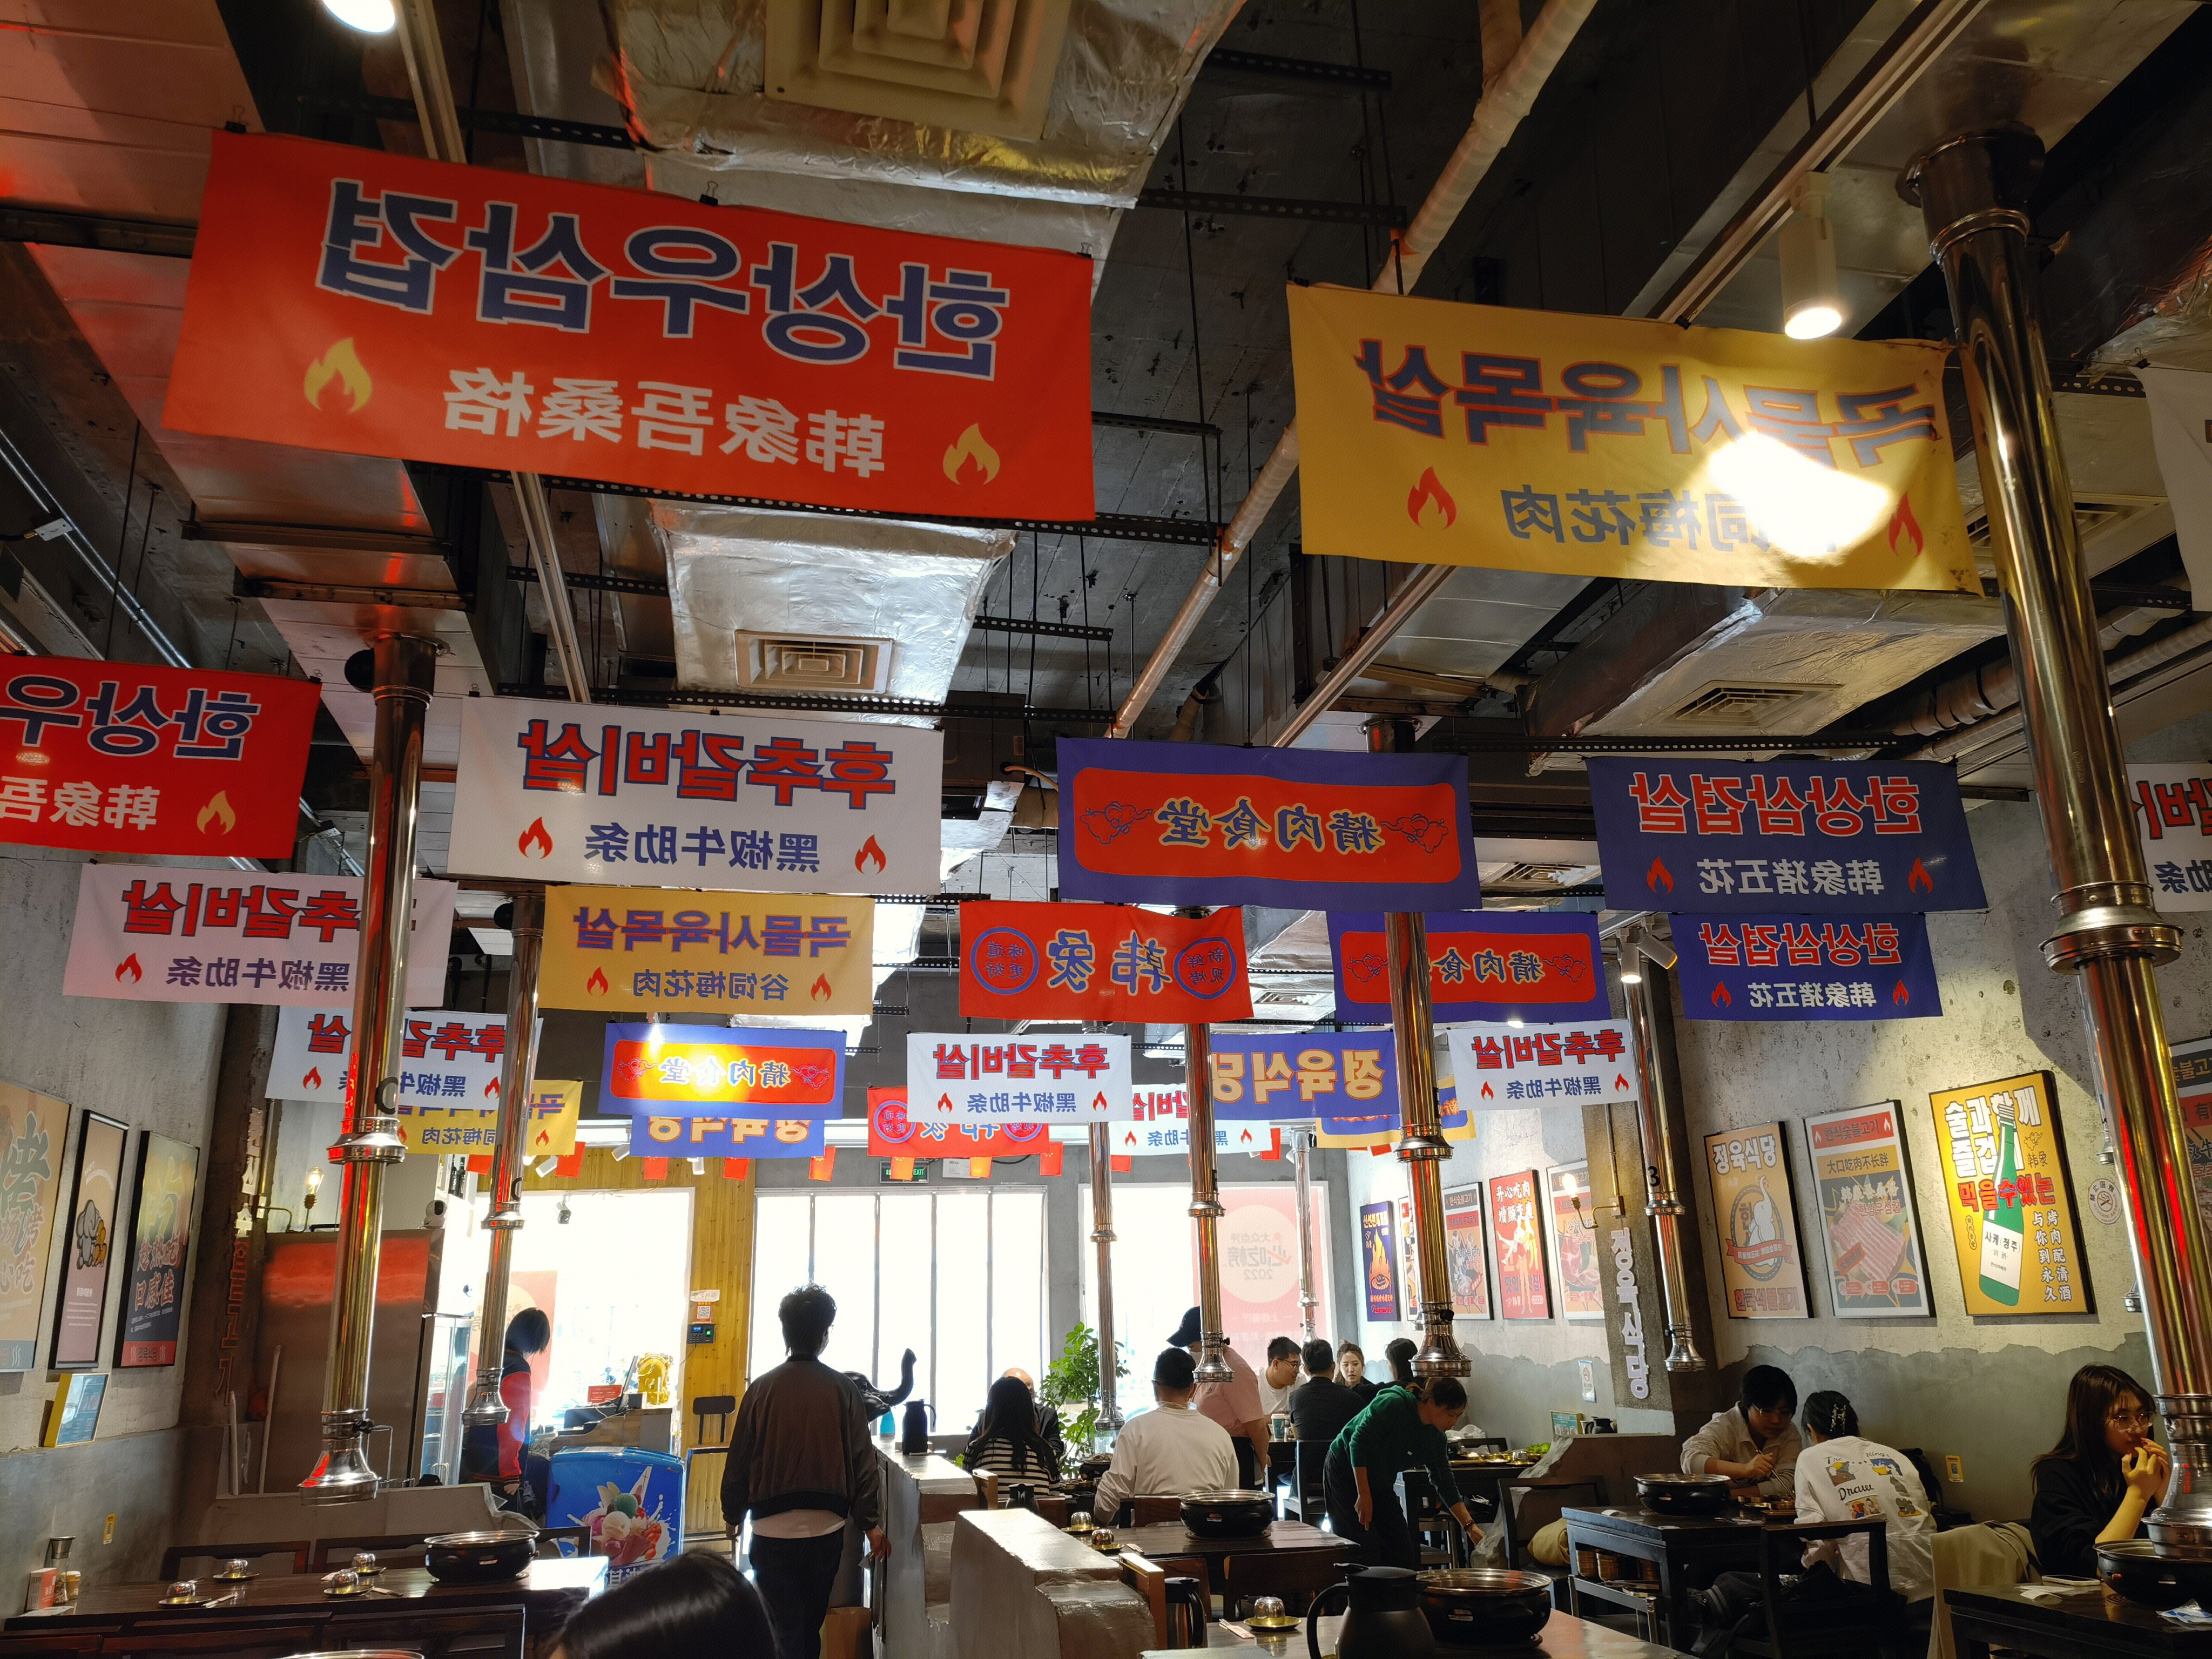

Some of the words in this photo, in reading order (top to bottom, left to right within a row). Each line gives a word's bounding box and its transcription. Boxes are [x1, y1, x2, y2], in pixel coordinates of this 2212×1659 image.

[1648, 1165, 1662, 1188] 3
[1712, 1133, 1776, 1175] 정육식당
[2033, 1211, 2058, 1302] 与你到永久
[2047, 1209, 2072, 1302] 烤肉配清酒
